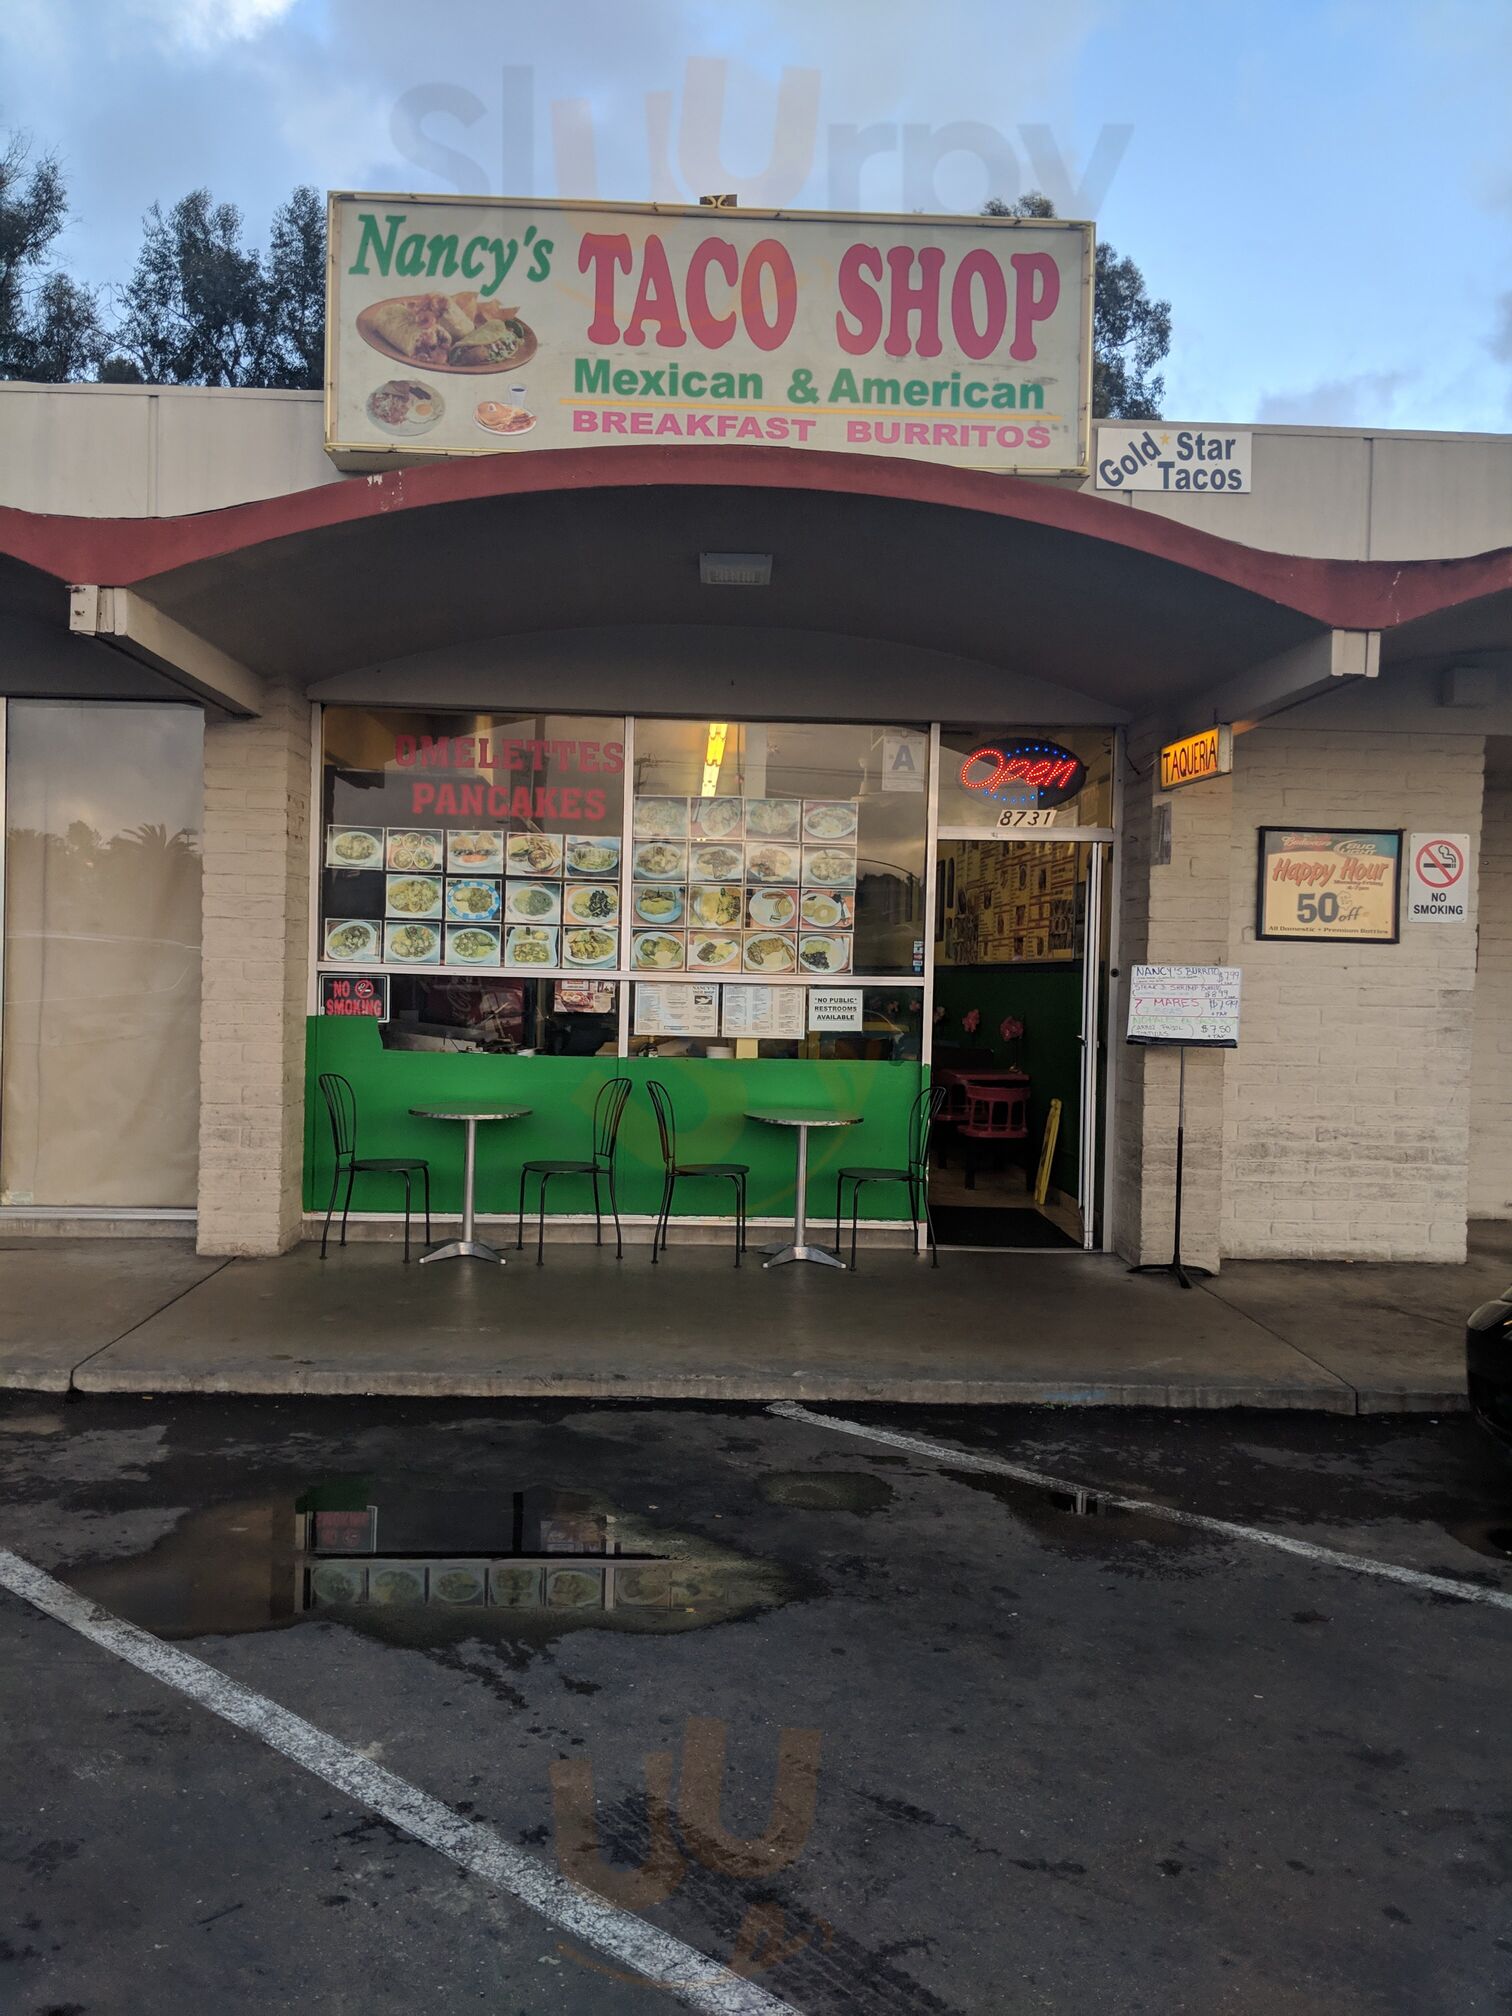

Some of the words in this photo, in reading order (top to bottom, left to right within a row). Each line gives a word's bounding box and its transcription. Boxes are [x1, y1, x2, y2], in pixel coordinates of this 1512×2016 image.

[348, 214, 554, 297] Nancy's
[578, 233, 797, 352] TACO
[836, 244, 1060, 362] SHOP
[575, 358, 763, 399] Mexican
[787, 369, 820, 404] &
[828, 368, 1044, 409] American
[573, 410, 816, 441] BREAKFAST
[847, 421, 1050, 448] BURRITOS
[1099, 431, 1162, 487] Gold
[1176, 432, 1236, 461] Star
[1158, 461, 1242, 490] Tacos
[395, 735, 624, 774] OMELETTES
[892, 745, 915, 770] A
[1163, 736, 1217, 784] TAQUERIA
[960, 750, 1077, 792] Open
[412, 782, 606, 821] PANCAKES
[1000, 811, 1052, 826] 8731
[1273, 858, 1336, 887] Happy
[1340, 858, 1389, 881] Hour
[1297, 891, 1339, 923] 50
[1339, 905, 1363, 922] off
[1414, 904, 1463, 915] SMOKING
[1432, 892, 1446, 902] NO
[1136, 966, 1182, 977] NANCY'S
[1186, 967, 1219, 976] BURRITO
[333, 980, 350, 997] NO
[1154, 998, 1199, 1008] MARES
[326, 999, 382, 1016] SMOKING
